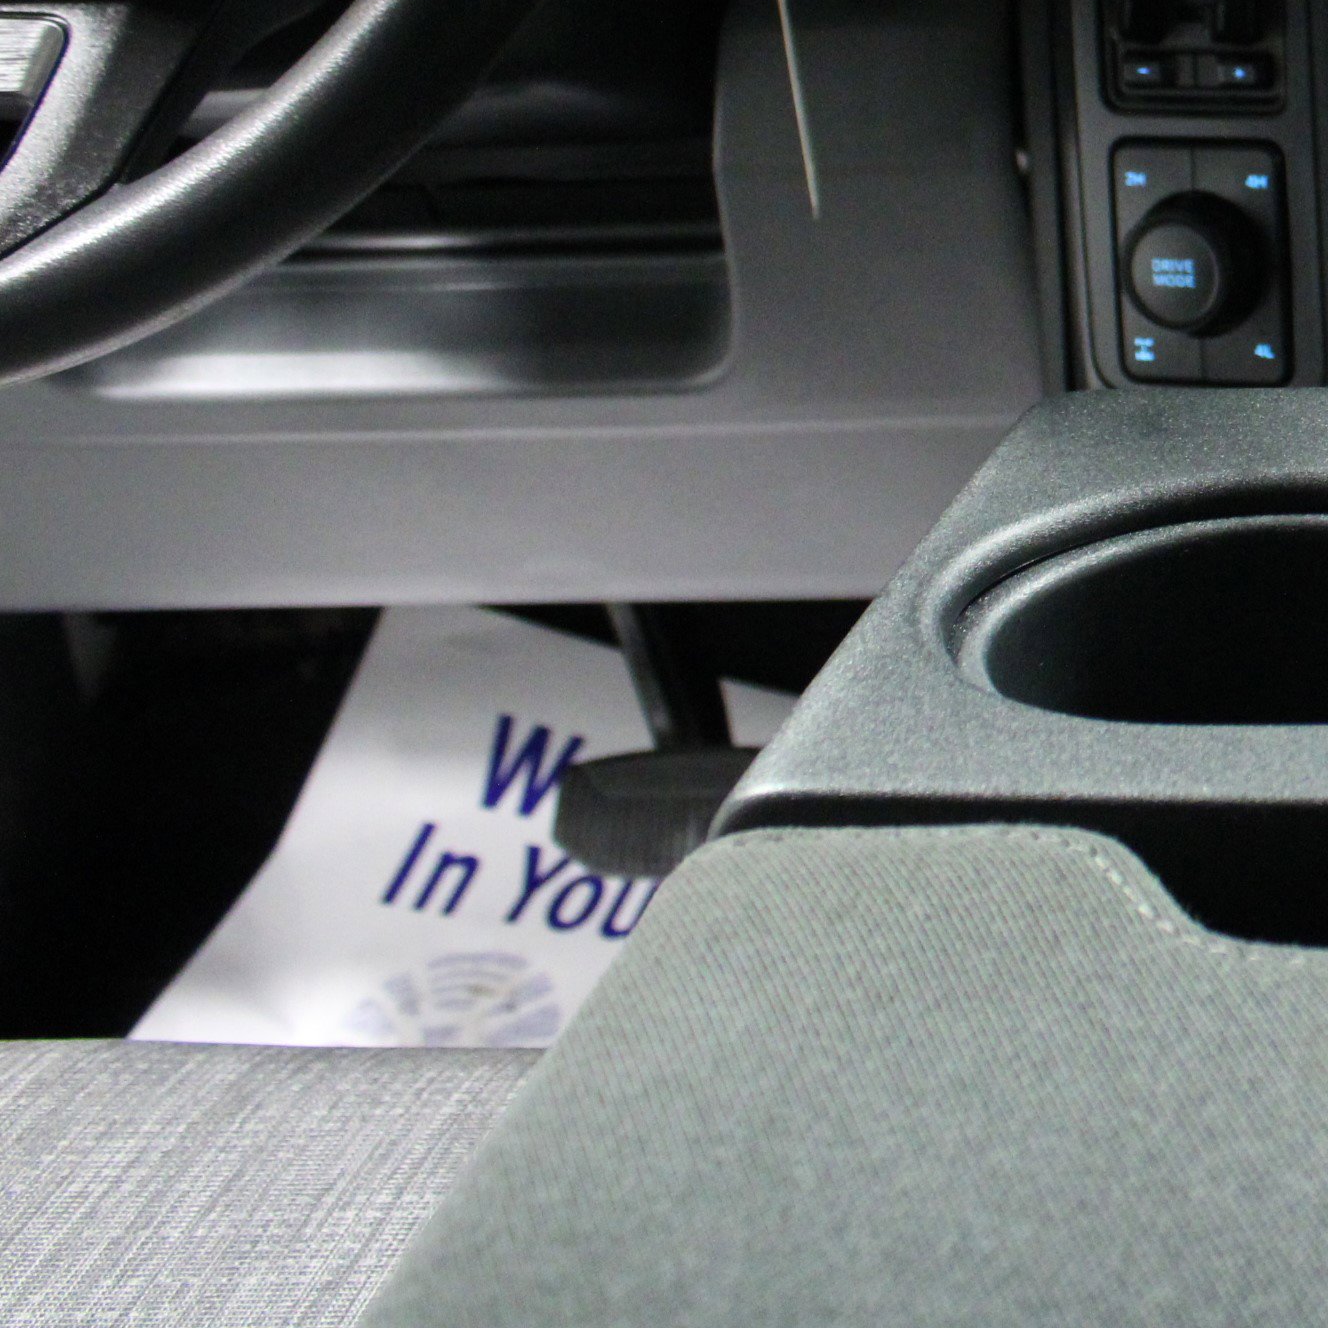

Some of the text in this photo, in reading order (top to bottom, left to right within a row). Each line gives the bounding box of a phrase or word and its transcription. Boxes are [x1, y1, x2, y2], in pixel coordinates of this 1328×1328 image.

[1151, 258, 1195, 273] DRIVE
[1152, 273, 1196, 289] MODE
[381, 823, 480, 916] In
